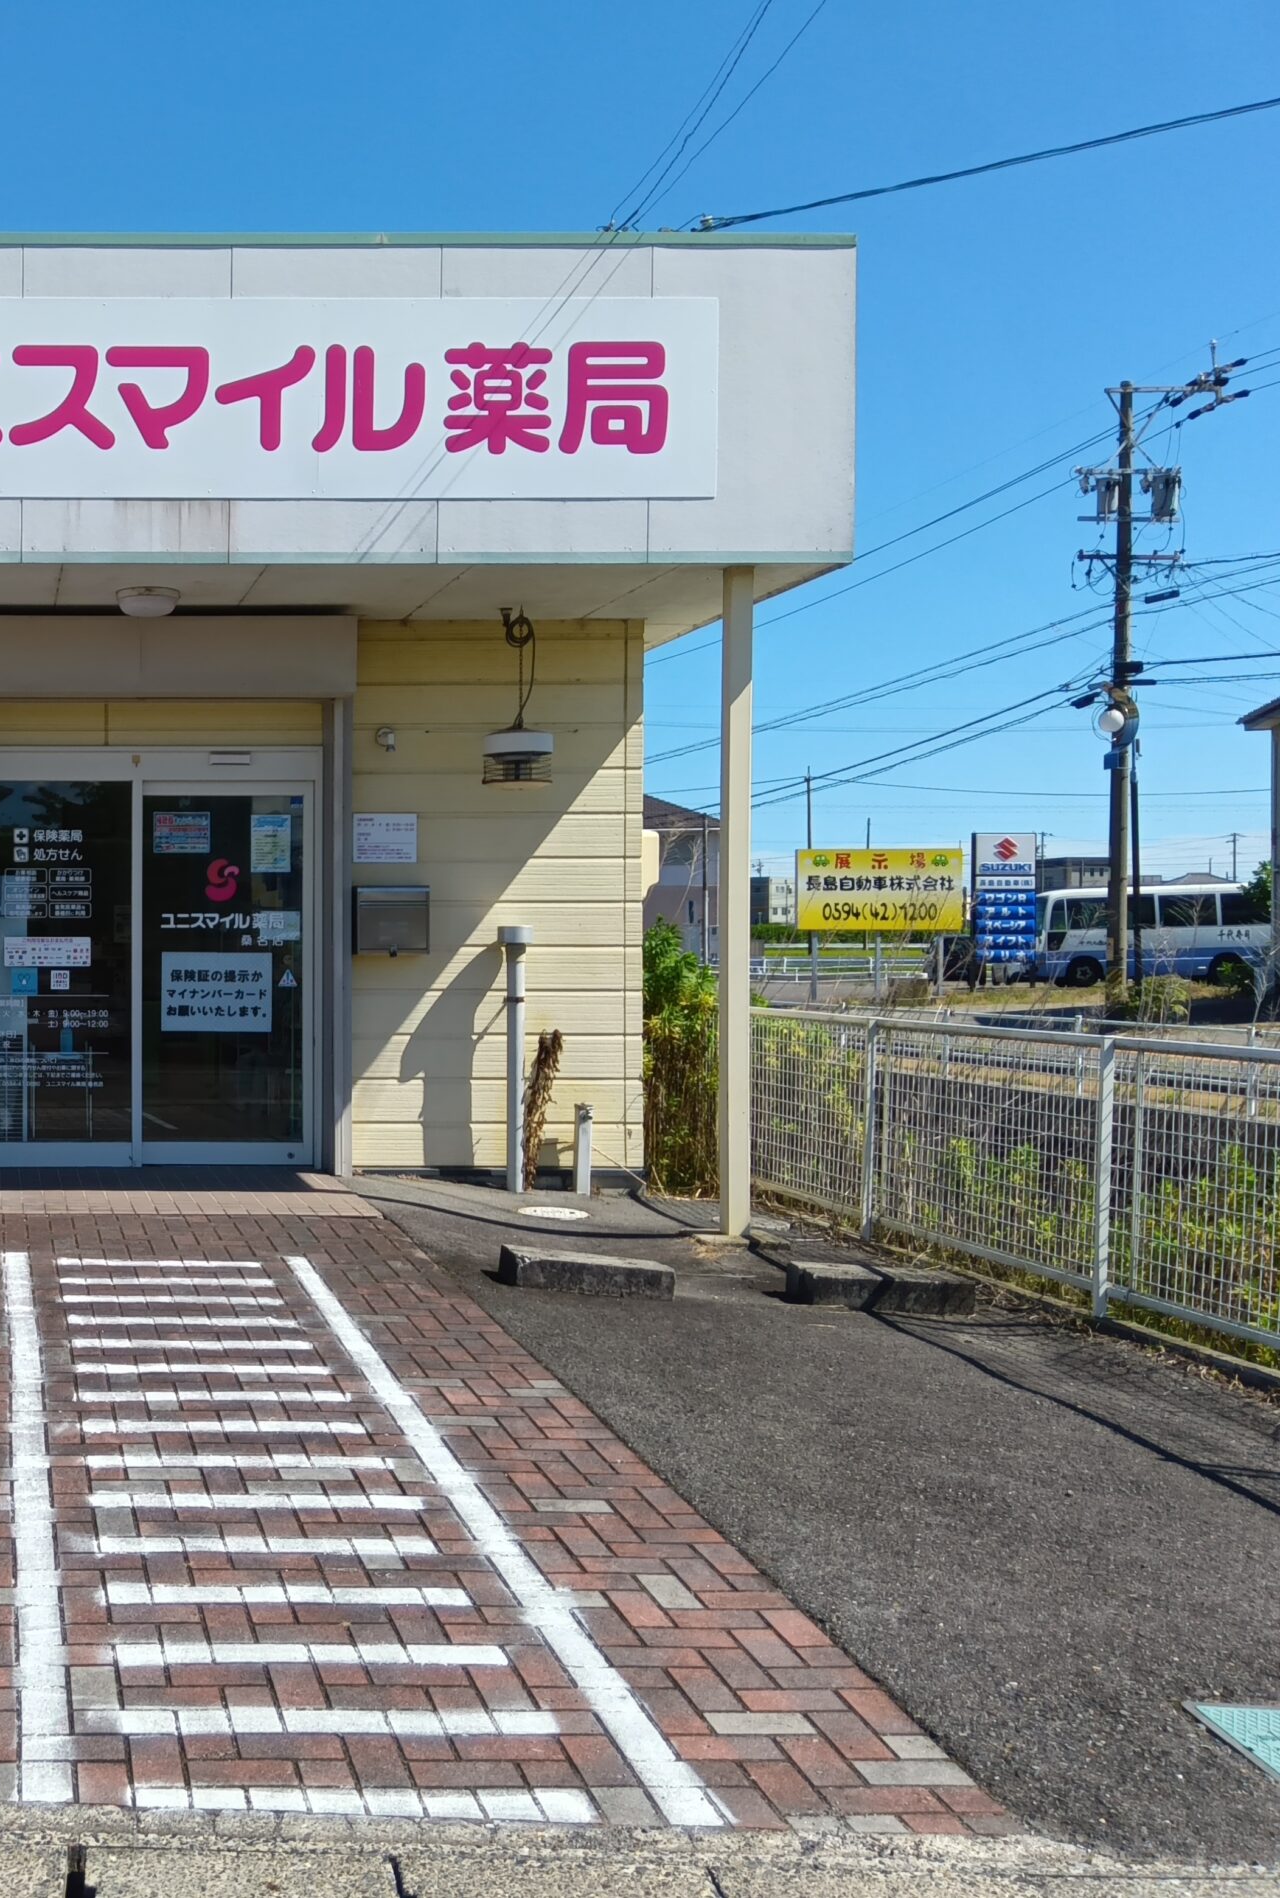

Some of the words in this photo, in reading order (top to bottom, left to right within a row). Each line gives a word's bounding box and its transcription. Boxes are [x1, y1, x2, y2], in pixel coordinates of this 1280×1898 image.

[33, 829, 83, 843] 保険薬局
[33, 848, 83, 861] 処方せん
[834, 853, 927, 870] 展示場
[978, 862, 1032, 873] SUZUKI
[805, 875, 955, 892] 長島自動車株式会社
[822, 901, 938, 922] 0594(42)1200
[161, 913, 284, 929] ユニスマイル薬局
[241, 935, 284, 947] 桑名店
[170, 969, 264, 983] 保険証の提示か
[166, 989, 267, 1000] マイナンバーカード
[166, 1005, 267, 1018] お願いいたします。
